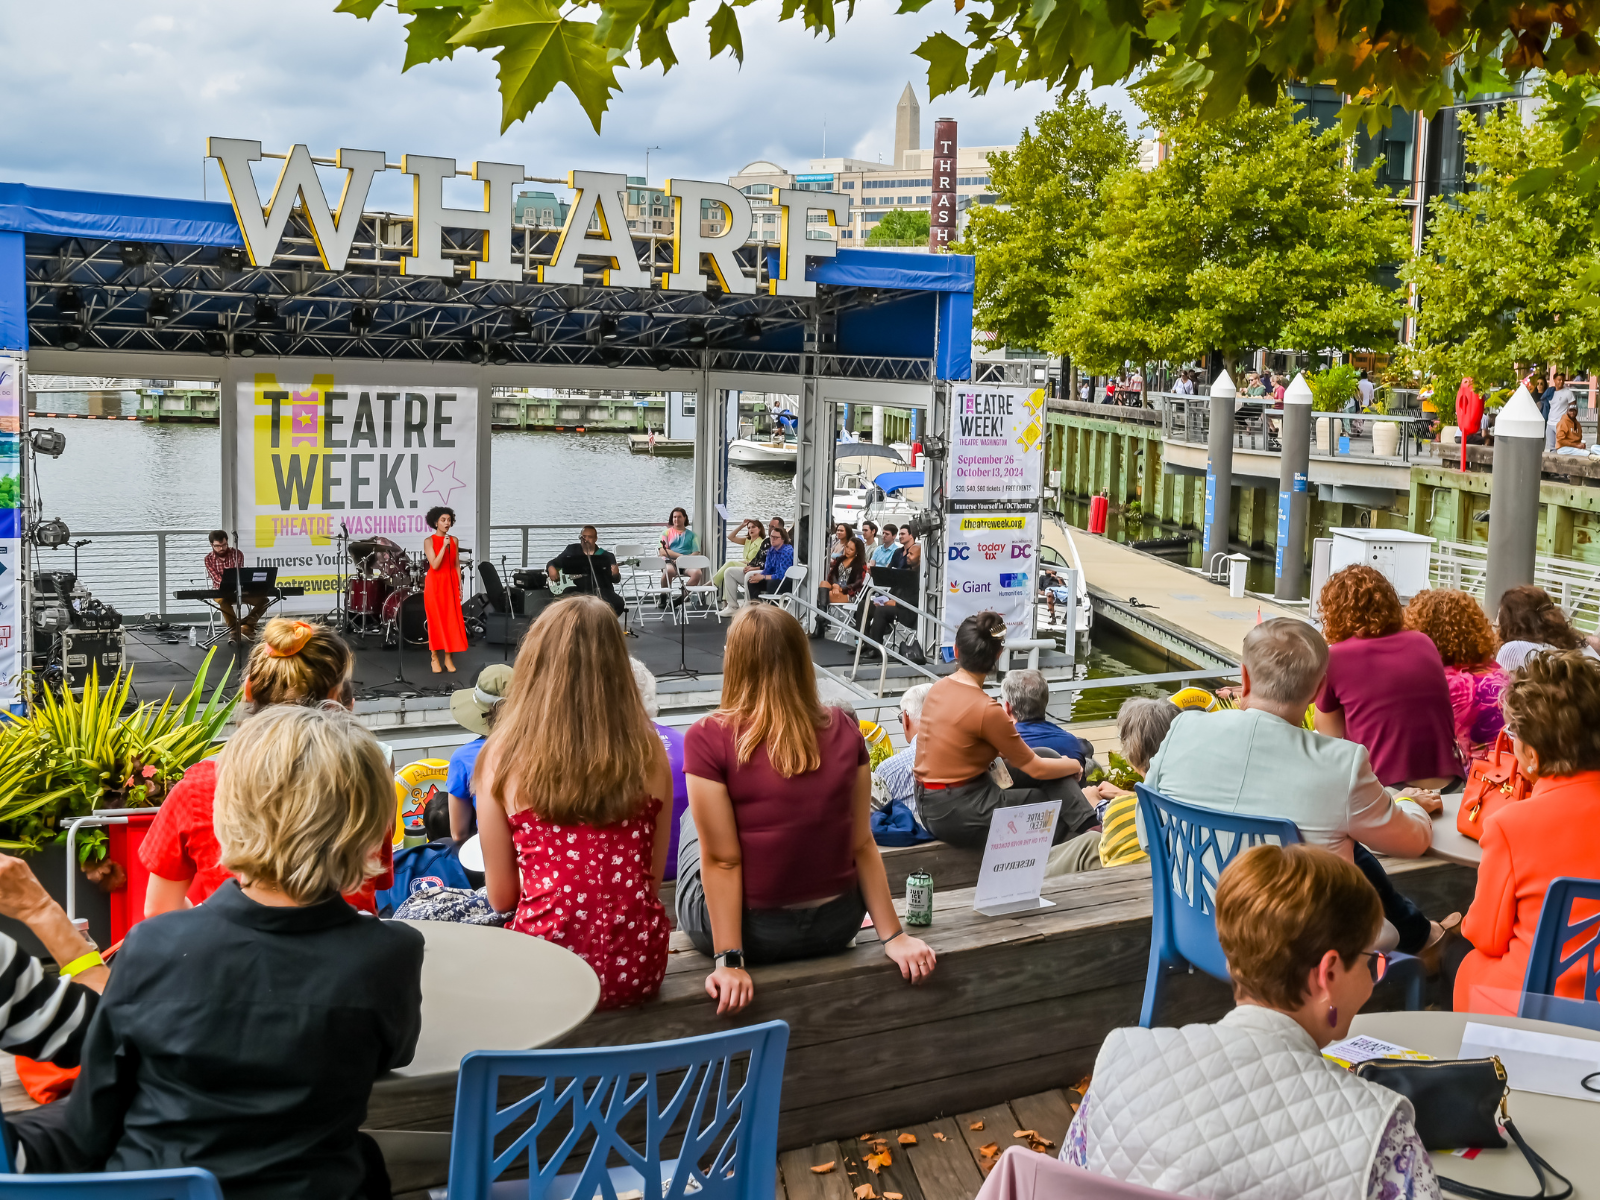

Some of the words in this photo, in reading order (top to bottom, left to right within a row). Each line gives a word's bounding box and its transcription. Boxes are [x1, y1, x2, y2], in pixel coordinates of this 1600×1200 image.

[207, 136, 850, 297] WHARF
[960, 416, 1003, 437] WEEK!
[958, 454, 1003, 466] September
[1004, 455, 1014, 464] 26
[957, 467, 991, 477] October
[992, 468, 1002, 478] 13,
[1004, 467, 1023, 477] 2024
[271, 453, 419, 511] WEEK!
[272, 516, 334, 536] THEATRE
[341, 514, 433, 534] WASHINGTON
[964, 519, 1023, 529] theatreweek.org
[949, 546, 970, 561] DC
[977, 542, 1006, 553] today
[1011, 544, 1032, 559] DC
[257, 556, 313, 567] Immerse
[985, 551, 997, 560] tix
[962, 581, 992, 593] Giant
